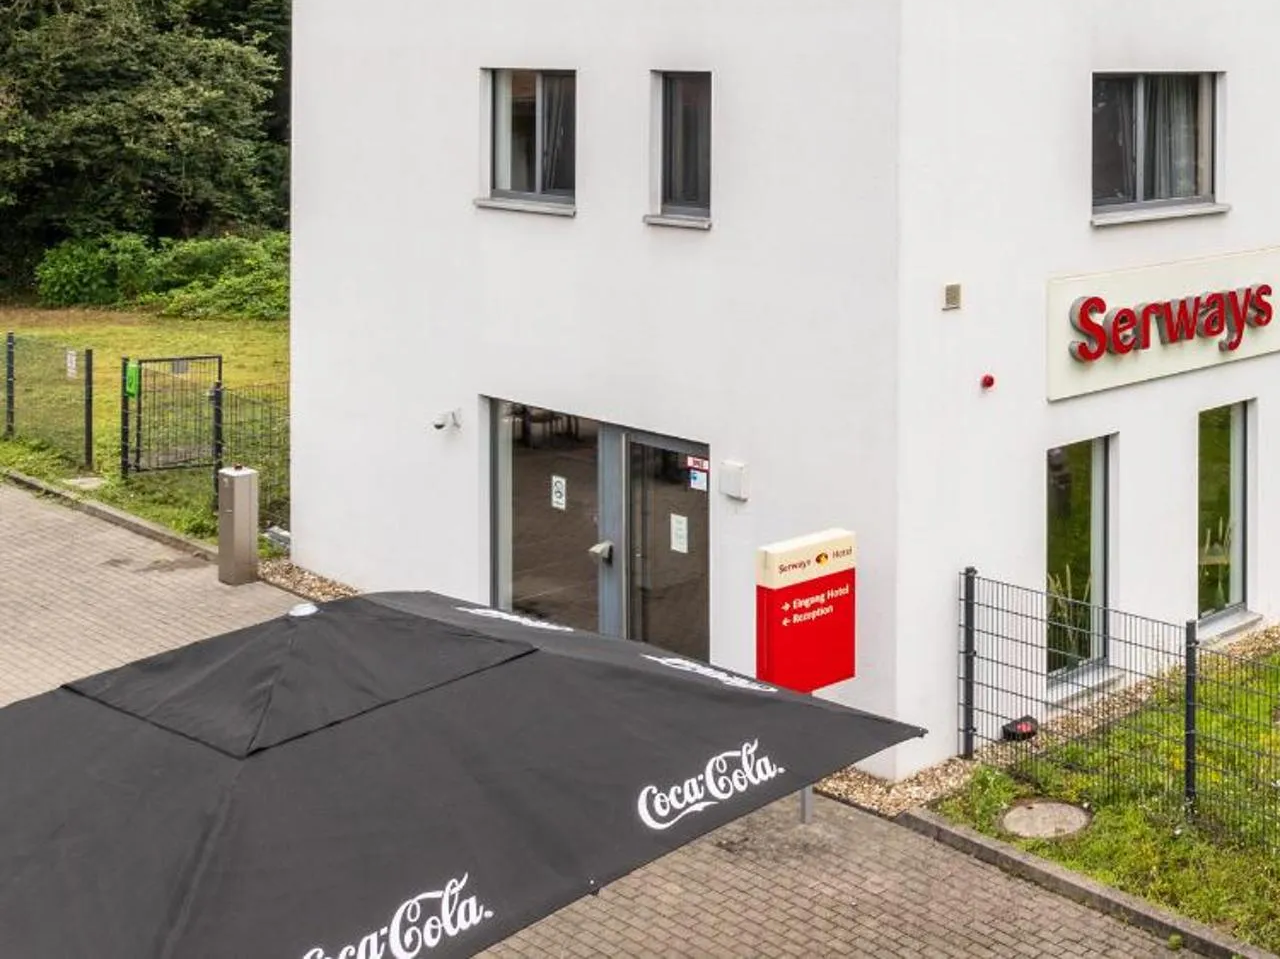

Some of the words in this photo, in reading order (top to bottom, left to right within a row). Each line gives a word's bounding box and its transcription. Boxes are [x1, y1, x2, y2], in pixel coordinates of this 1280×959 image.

[1069, 284, 1273, 363] Serways
[778, 559, 811, 574] Serways
[832, 546, 852, 560] Hotel
[793, 593, 826, 609] Eingang
[827, 583, 850, 600] Hotel
